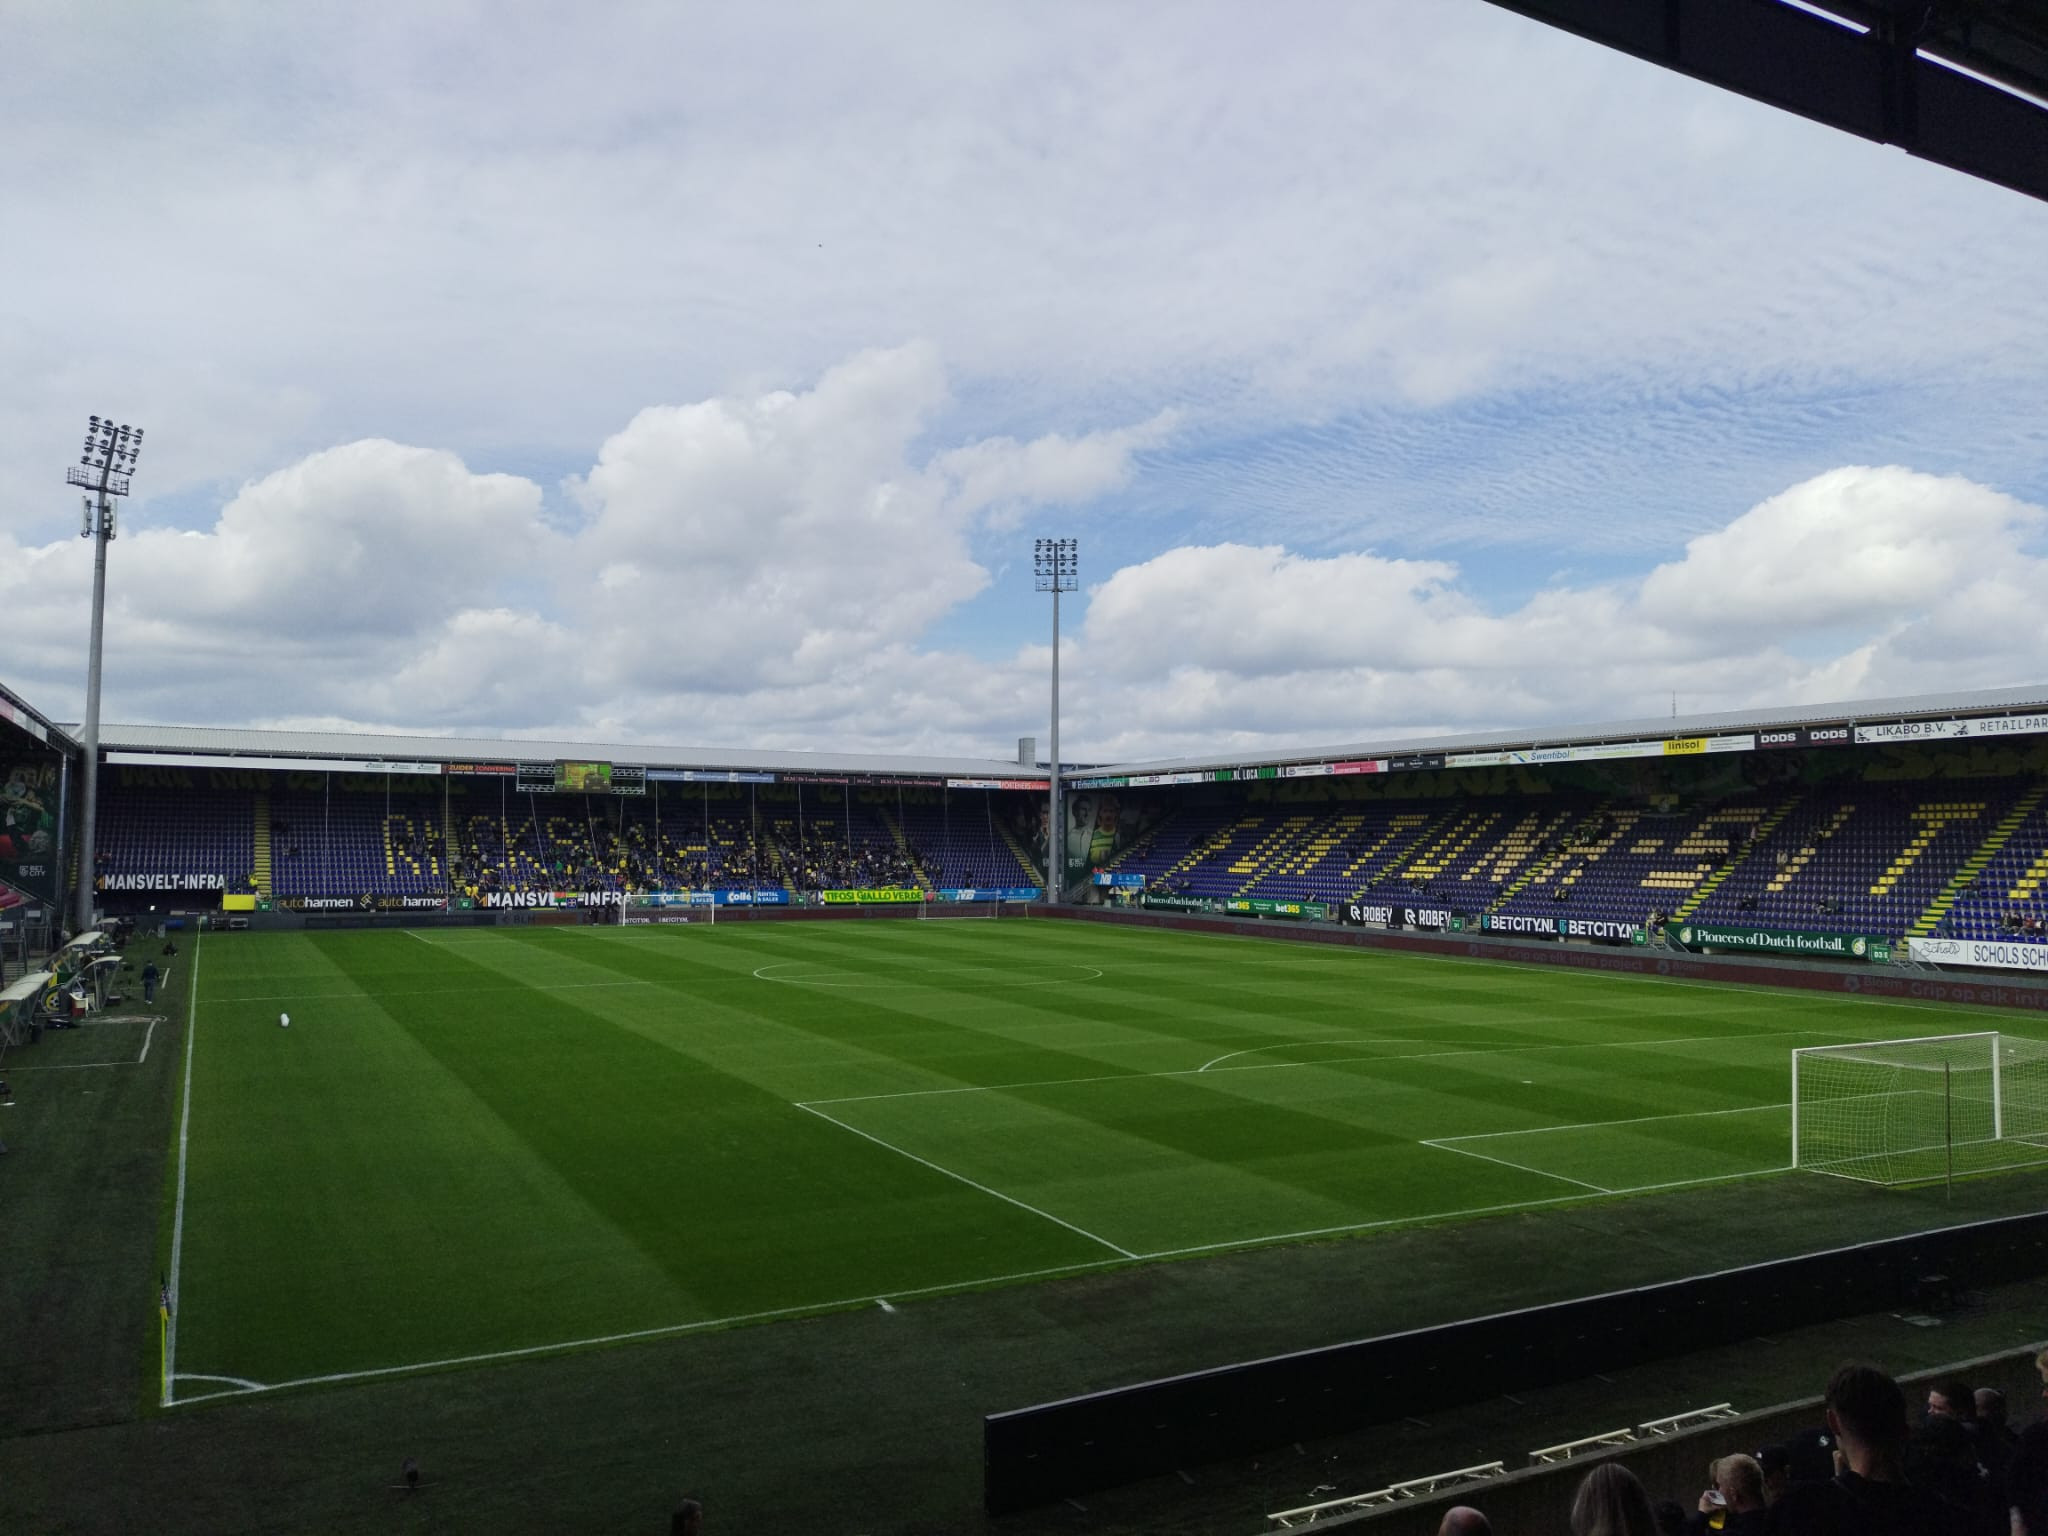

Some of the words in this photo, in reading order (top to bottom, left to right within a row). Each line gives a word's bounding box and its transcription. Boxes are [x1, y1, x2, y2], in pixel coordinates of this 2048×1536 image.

[1876, 724, 1921, 737] LIKABO
[1924, 722, 1946, 734] B.V.
[1979, 717, 2048, 733] RETAILPAR
[1760, 732, 1797, 743] DODS
[1810, 729, 1848, 740] DODS
[1668, 740, 1700, 751] linisol
[448, 764, 474, 772] ZUIDER
[104, 873, 225, 890] MANSVELT-INFRA
[279, 896, 354, 908] autoharmen
[377, 895, 447, 907] autoharme
[824, 890, 855, 901] TIFOSI
[857, 890, 891, 901] GIALLO
[893, 890, 922, 900] VERDE
[1227, 900, 1250, 910] bet365
[1275, 903, 1300, 914] bet365
[1363, 906, 1393, 923] ROBEY
[1418, 908, 1451, 927] ROBEY
[1490, 915, 1558, 934] BETCITY.NL
[1697, 929, 1744, 945] Pioneers
[1745, 932, 1759, 945] of
[1760, 933, 1795, 948] Dutch
[1796, 935, 1846, 951] football.
[1920, 941, 1961, 956] Schols
[1974, 944, 2019, 965] SCHOLS
[2021, 946, 2048, 968] SCH
[1910, 982, 1945, 1001] Grip
[1951, 988, 1976, 1002] op
[1980, 987, 2009, 1004] elk
